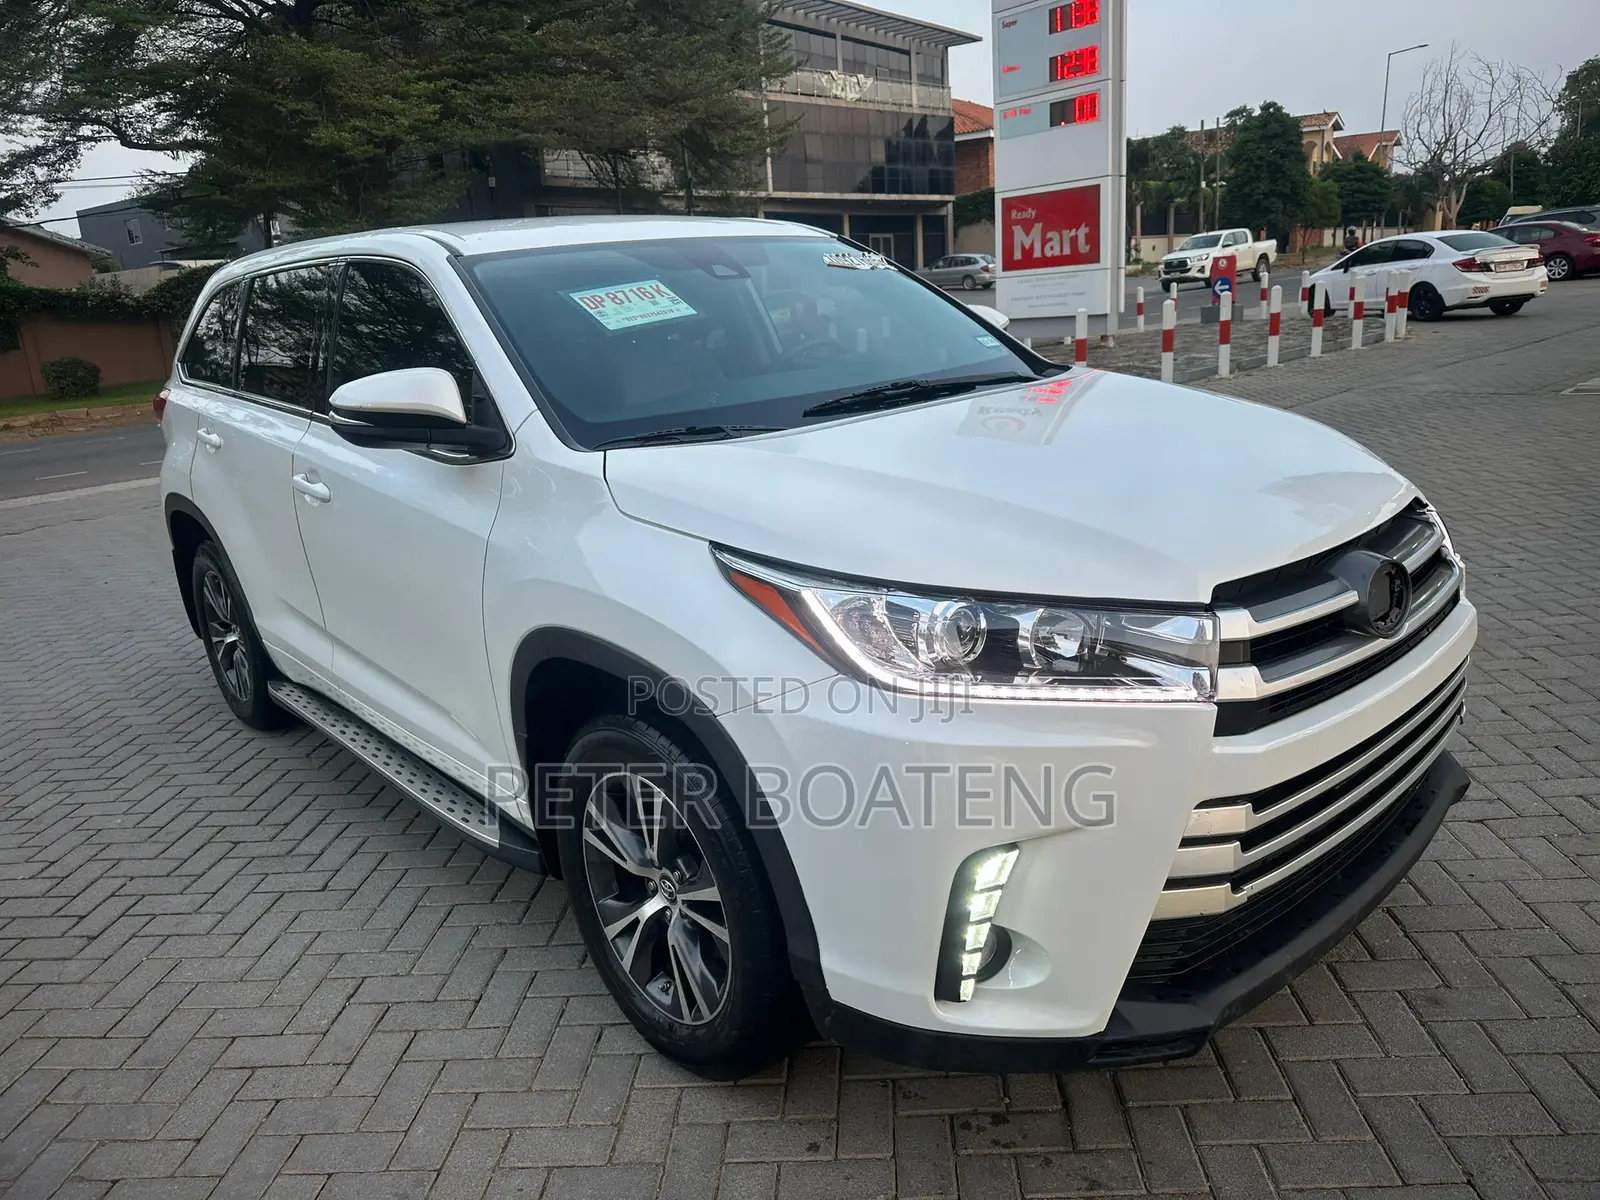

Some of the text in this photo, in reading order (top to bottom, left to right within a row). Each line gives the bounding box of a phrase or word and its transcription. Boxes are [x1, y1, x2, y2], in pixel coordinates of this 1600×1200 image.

[1002, 18, 1018, 29] Super
[1056, 45, 1099, 80] 1238
[1011, 208, 1037, 220] Ready
[1012, 222, 1091, 260] Mart
